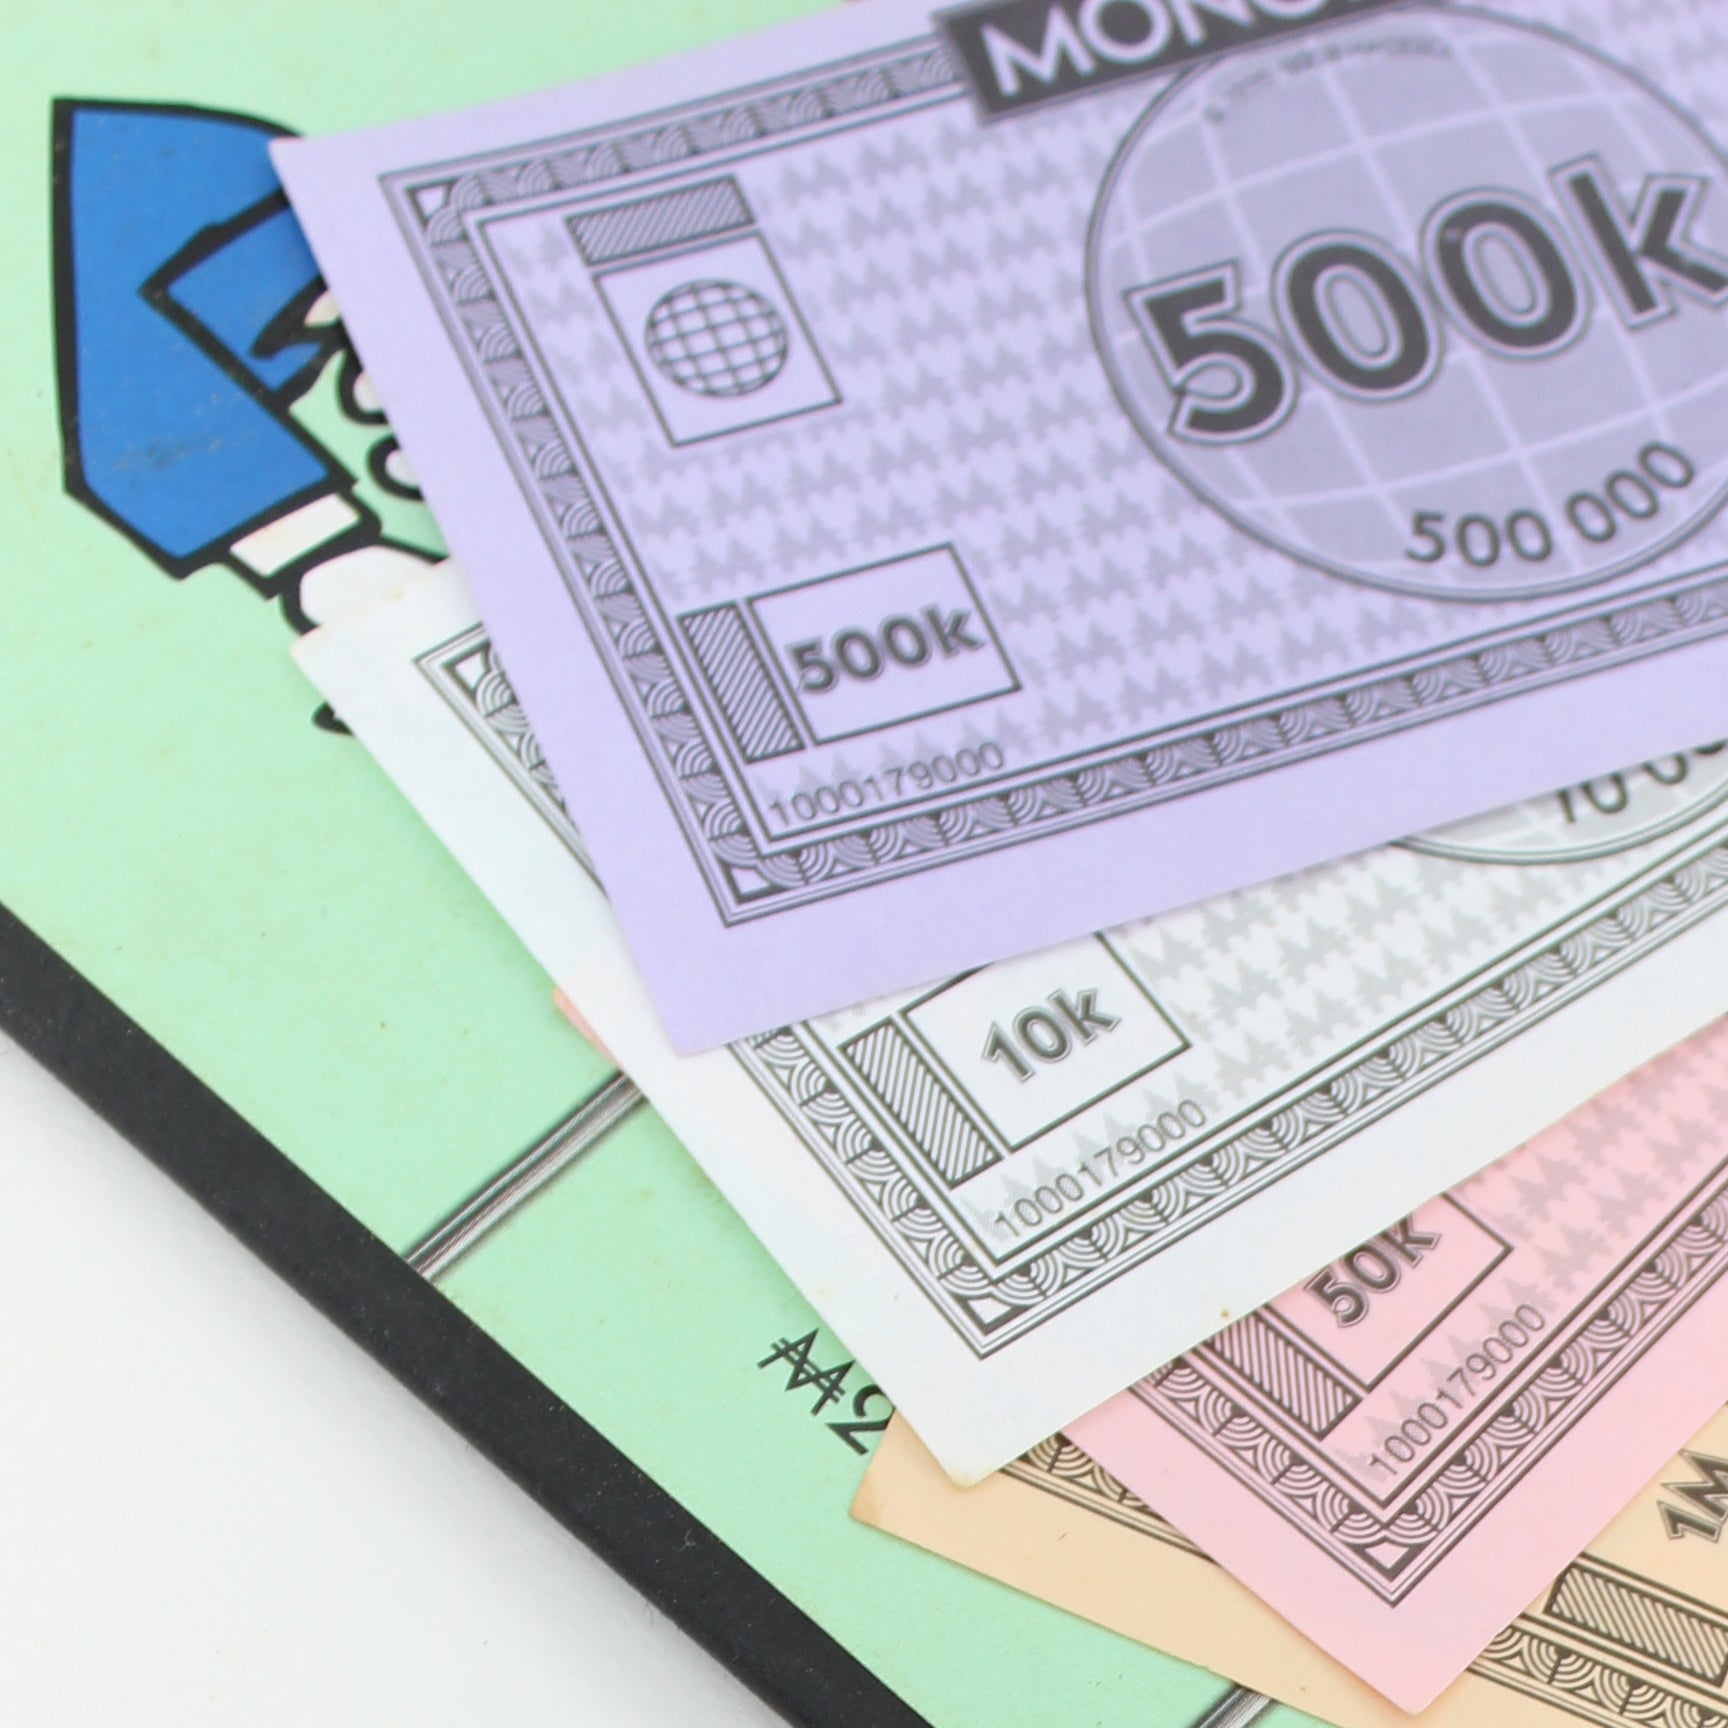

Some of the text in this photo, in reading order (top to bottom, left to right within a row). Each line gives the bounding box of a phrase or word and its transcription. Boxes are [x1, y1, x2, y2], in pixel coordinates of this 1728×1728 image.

[1406, 441, 1695, 567] 500 000
[784, 602, 986, 693] 500k
[769, 741, 1005, 828] 1000179000
[980, 987, 1122, 1083] 10k
[994, 1098, 1207, 1237] 1000179000
[1368, 1304, 1546, 1476] 1000179000
